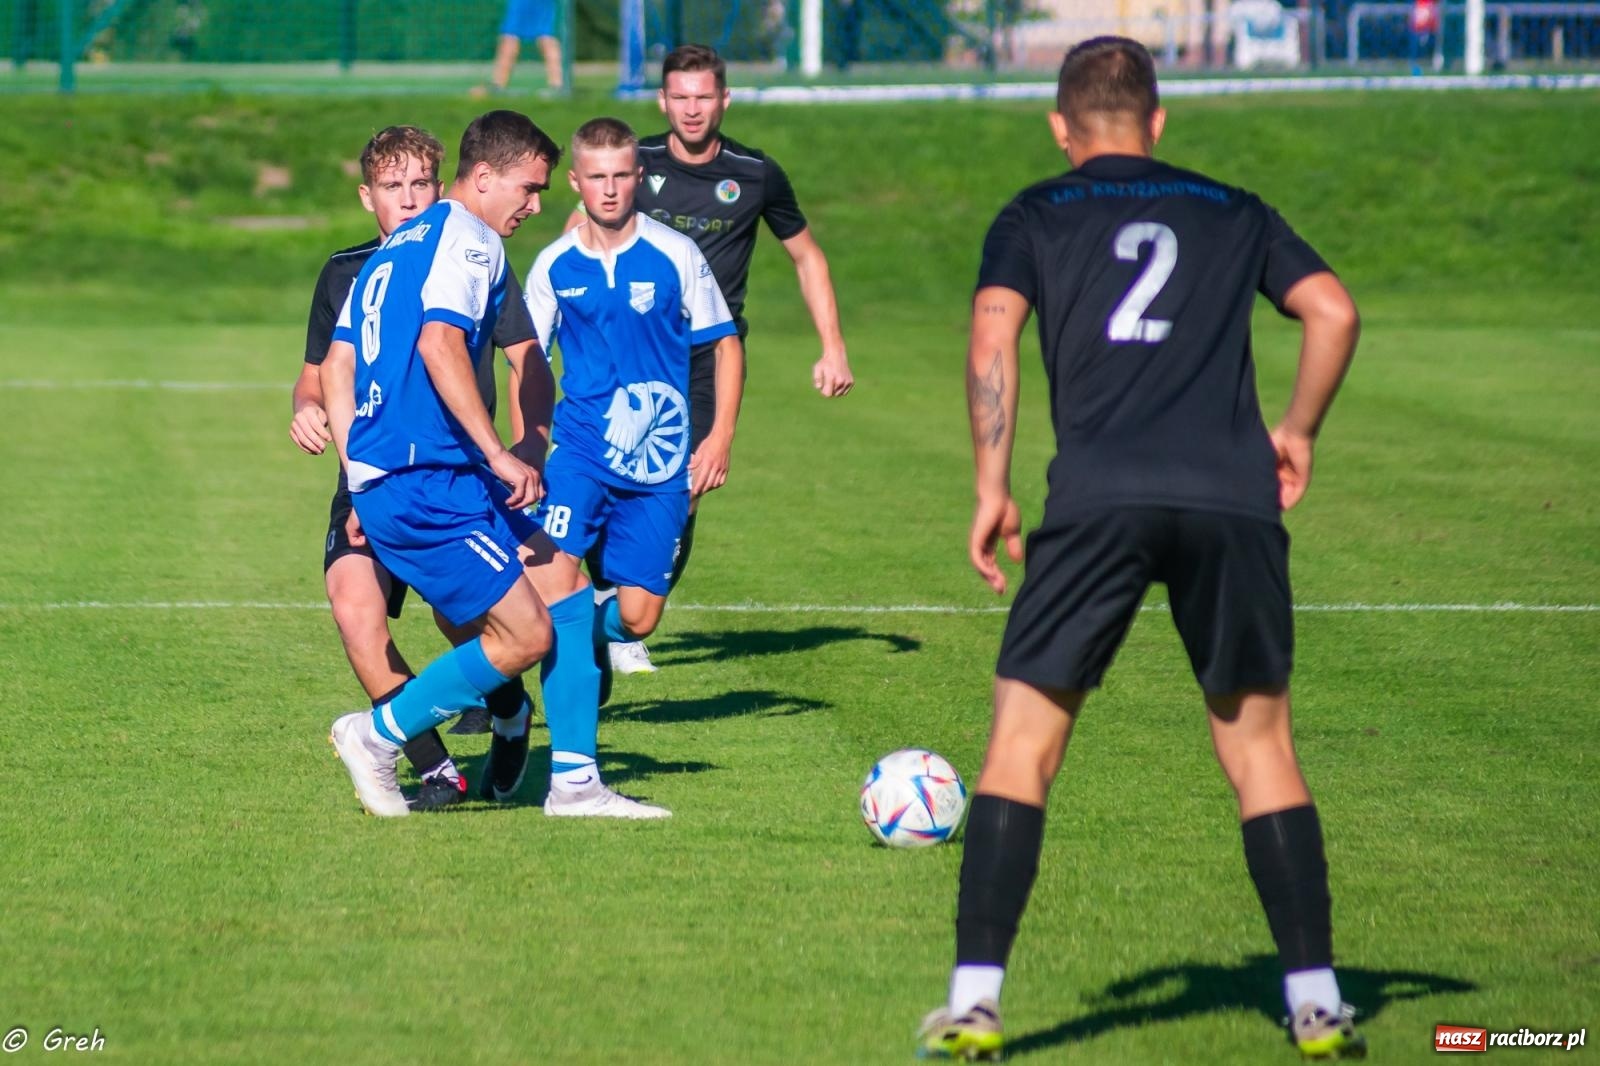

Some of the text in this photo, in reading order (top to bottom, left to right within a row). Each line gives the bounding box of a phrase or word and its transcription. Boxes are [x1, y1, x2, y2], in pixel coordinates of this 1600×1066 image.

[674, 215, 735, 232] SPORT
[361, 261, 393, 366] 8
[1108, 221, 1179, 343] 2
[543, 504, 572, 539] 18
